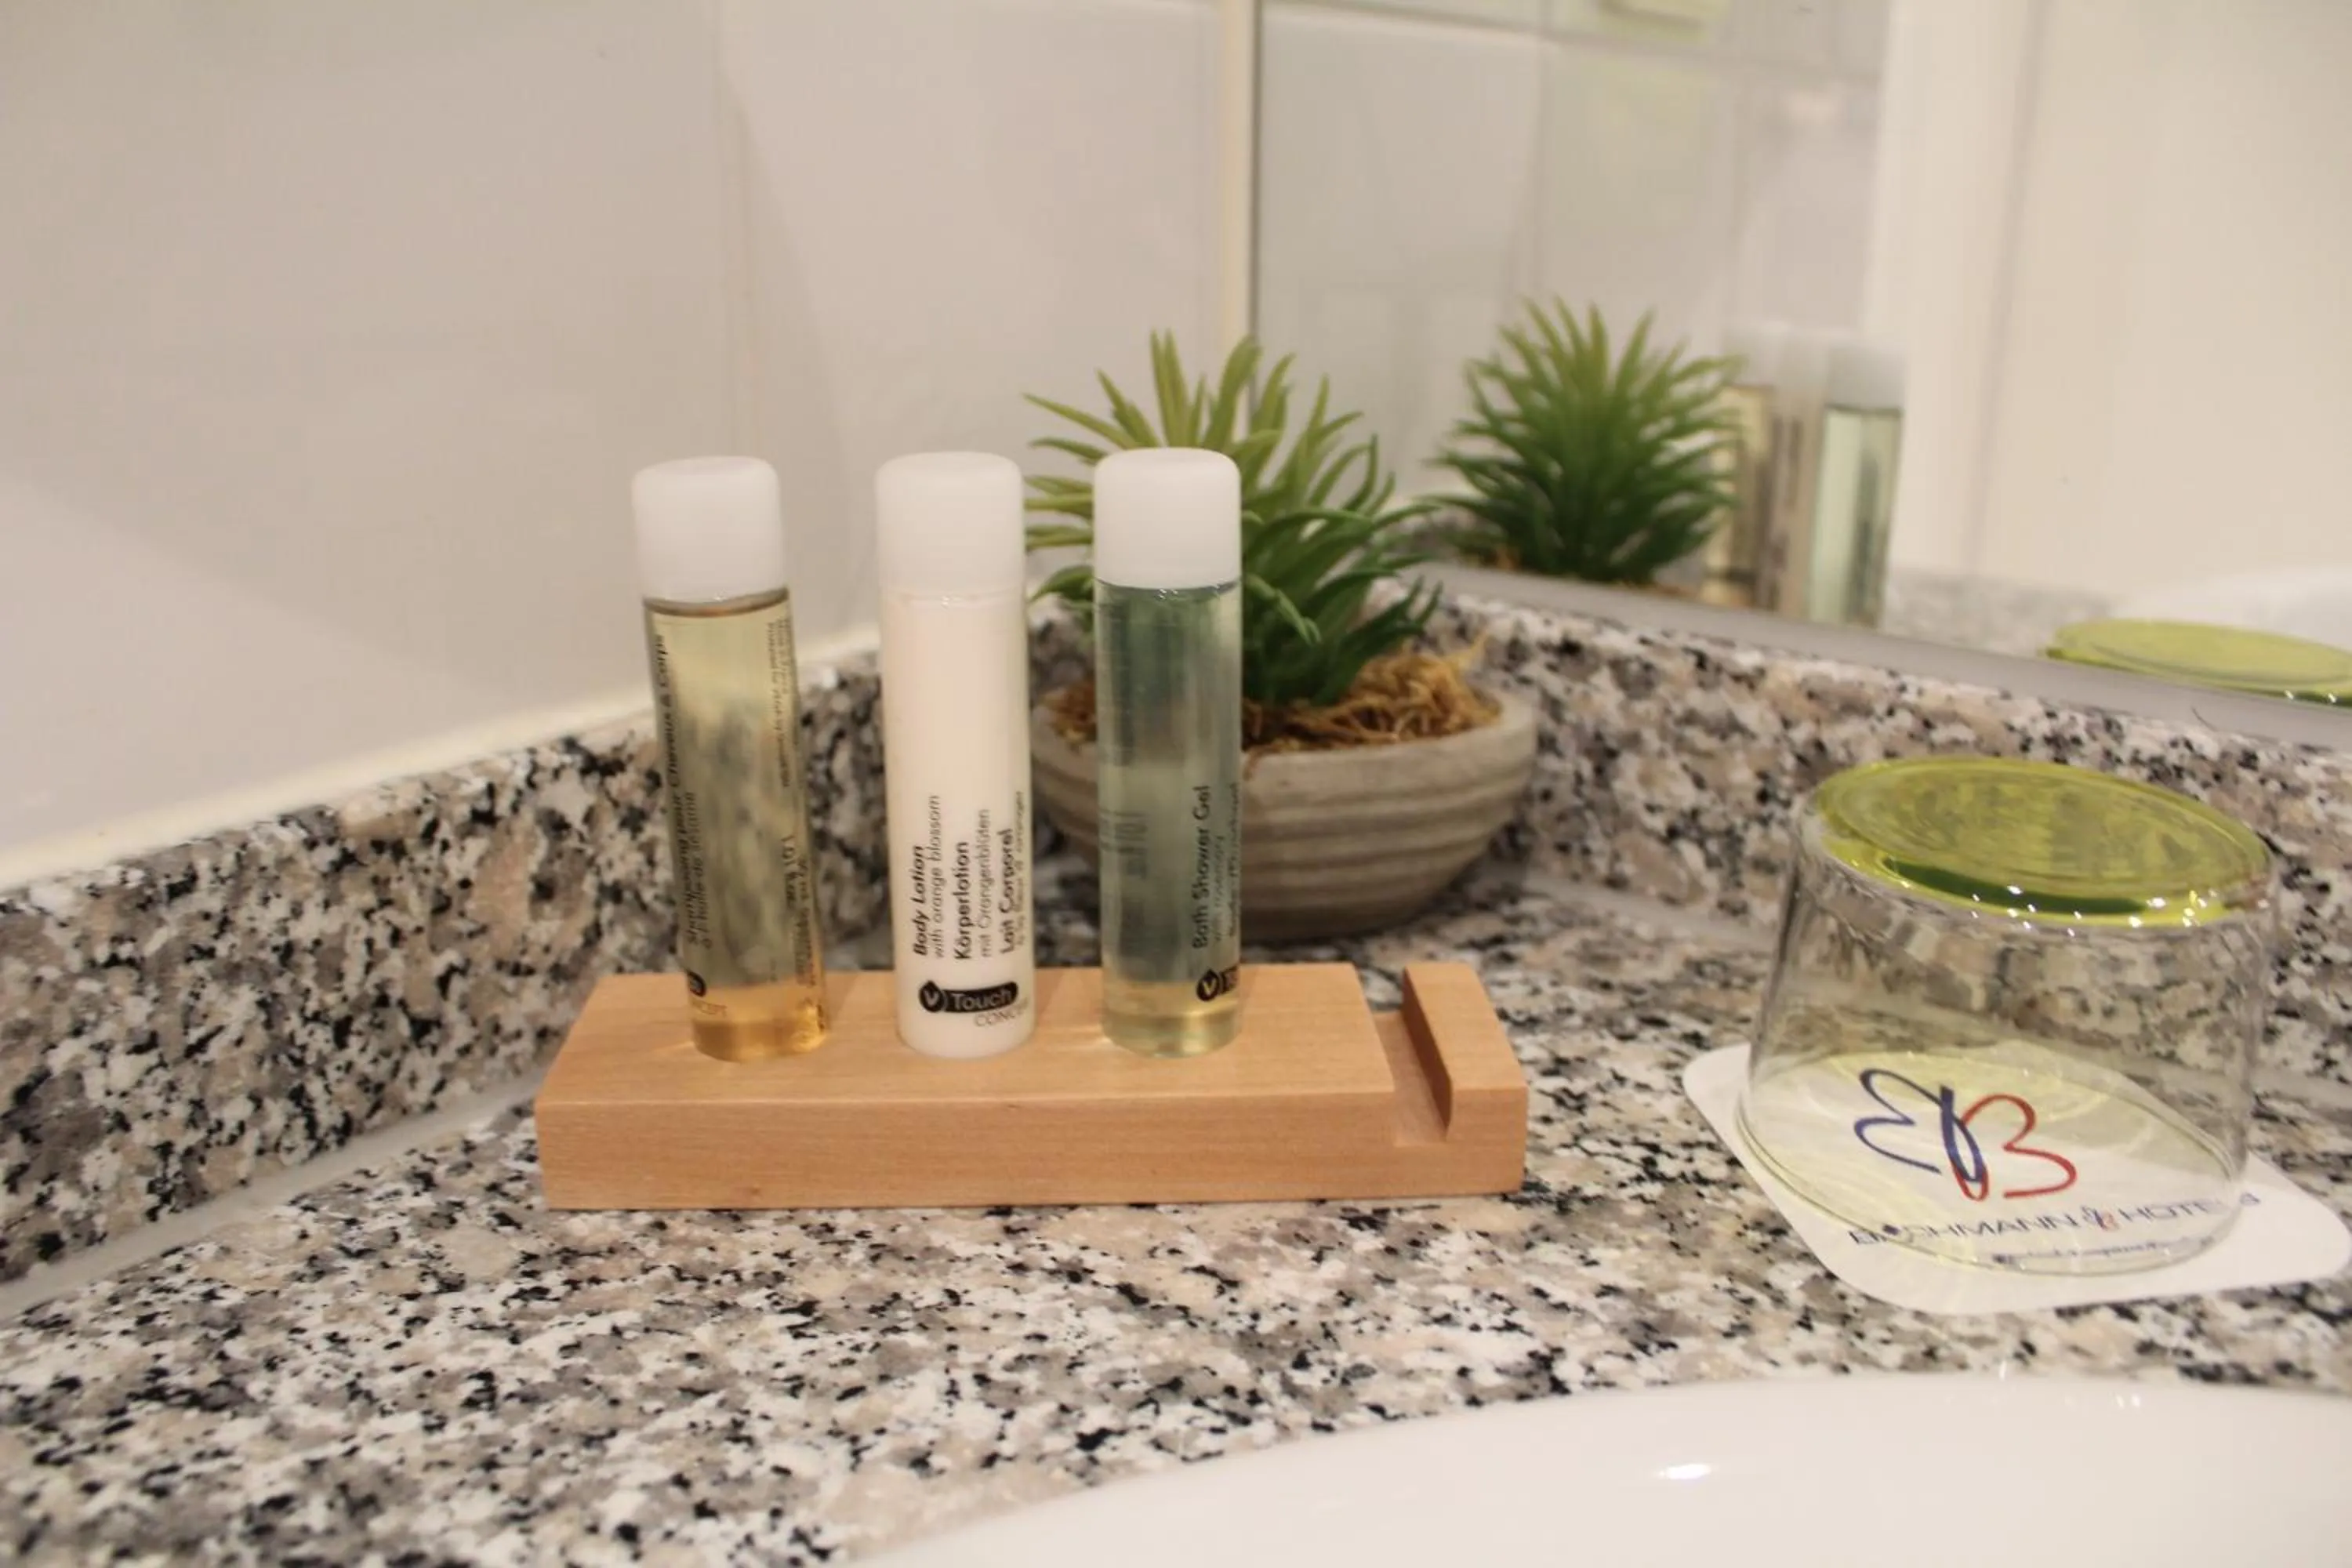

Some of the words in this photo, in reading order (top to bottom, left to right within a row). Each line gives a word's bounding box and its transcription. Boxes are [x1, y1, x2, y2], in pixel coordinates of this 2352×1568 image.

[925, 794, 942, 862] blossom
[1191, 785, 1210, 821] Gel
[909, 845, 927, 904] Lotion
[975, 808, 995, 929] Orangenblüten
[997, 828, 1016, 913] Corporel
[1191, 827, 1210, 900] Shower
[931, 868, 946, 924] orange
[951, 841, 974, 960] Körperlotion
[911, 909, 930, 956] Body
[928, 931, 944, 958] with
[977, 935, 992, 958] mit
[998, 920, 1016, 955] Lait
[1191, 905, 1209, 949] Bath
[951, 989, 1012, 1011] Touch
